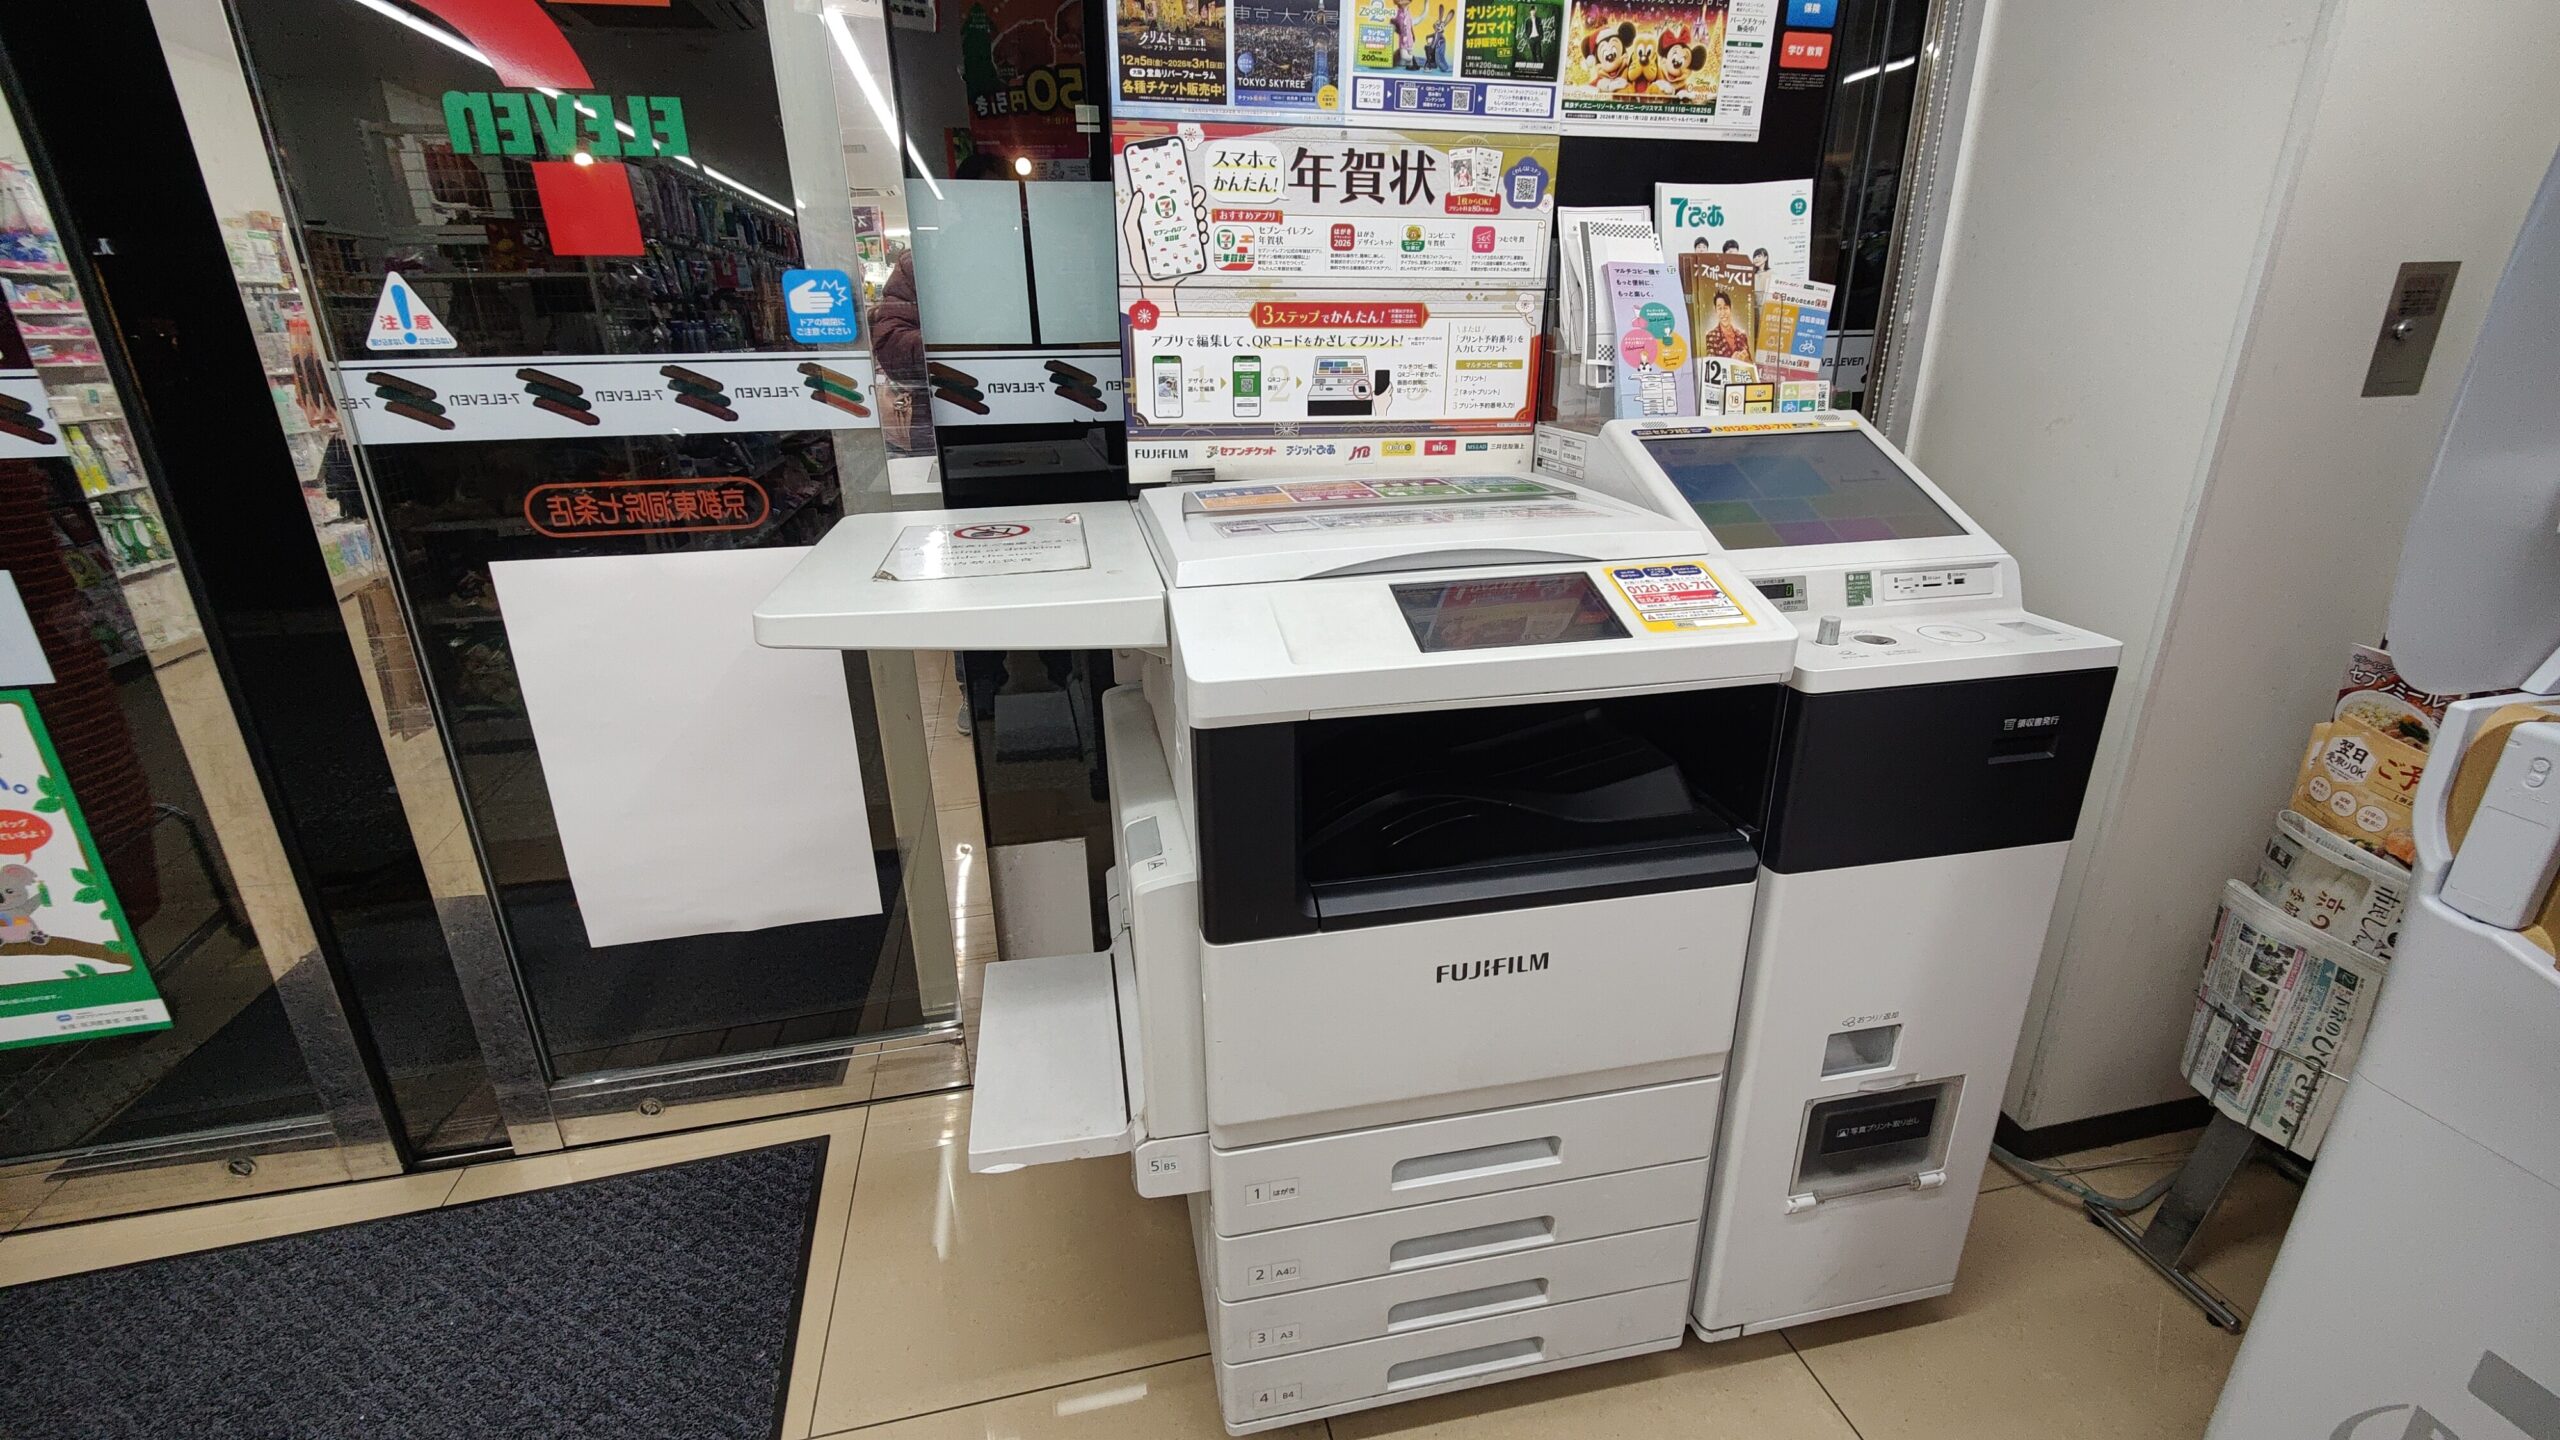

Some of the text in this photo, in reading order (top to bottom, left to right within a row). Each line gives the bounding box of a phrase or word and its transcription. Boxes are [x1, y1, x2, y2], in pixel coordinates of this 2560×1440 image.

[1466, 4, 1516, 18] オリジナル
[1804, 3, 1821, 14] 保険
[1466, 22, 1515, 35] ブロマイド
[1138, 31, 1175, 46] クリムト
[1788, 45, 1824, 57] 学び 教育
[1122, 79, 1225, 97] 各種チケット販売中!
[1237, 77, 1306, 89] TOKYO SKYTREE
[1213, 150, 1278, 169] スマホで
[1288, 146, 1436, 206] 年賀状
[1214, 175, 1278, 193] かんたん!
[1219, 209, 1276, 221] おすすめアプリ
[1670, 197, 1725, 229] 7ぴあ
[1258, 236, 1284, 245] 年賀状
[1357, 230, 1375, 238] はがき
[1427, 231, 1456, 239] コンビニで
[1333, 239, 1352, 247] 2026
[1356, 238, 1394, 247] デザインキット
[1427, 239, 1446, 248] 年賀状
[1222, 253, 1247, 263] 年賀状
[1614, 268, 1660, 276] マルチコピー機で
[1701, 263, 1752, 286] スポーツくじ
[1262, 304, 1385, 325] 3ステップでかんたん!
[379, 314, 433, 331] 注 意
[1151, 334, 1404, 349] アプリで編集して、QRコードをかざしてプリント!
[1455, 345, 1508, 353] 入力してプリント
[1465, 361, 1514, 369] マルチコピー機にて
[1704, 360, 1721, 385] 12
[1268, 365, 1290, 403] 2
[1460, 388, 1501, 396] 「ネットプリント」
[1135, 448, 1188, 459] FUJIFILM
[1220, 446, 1277, 456] セブンチケット
[1627, 581, 1714, 594] 0120-310-711
[2335, 738, 2369, 764] 翌日
[2326, 751, 2367, 779] 受取りOK
[1436, 952, 1549, 983] FUJIFILM
[1850, 1117, 1920, 1135] 写真プリント取り出し
[1151, 1161, 1177, 1172] 5 B5
[1253, 1187, 1296, 1199] 1 はがき
[1256, 1267, 1290, 1280] 2 A4
[1257, 1330, 1294, 1344] 3 A3
[1260, 1391, 1294, 1403] 4 B4
